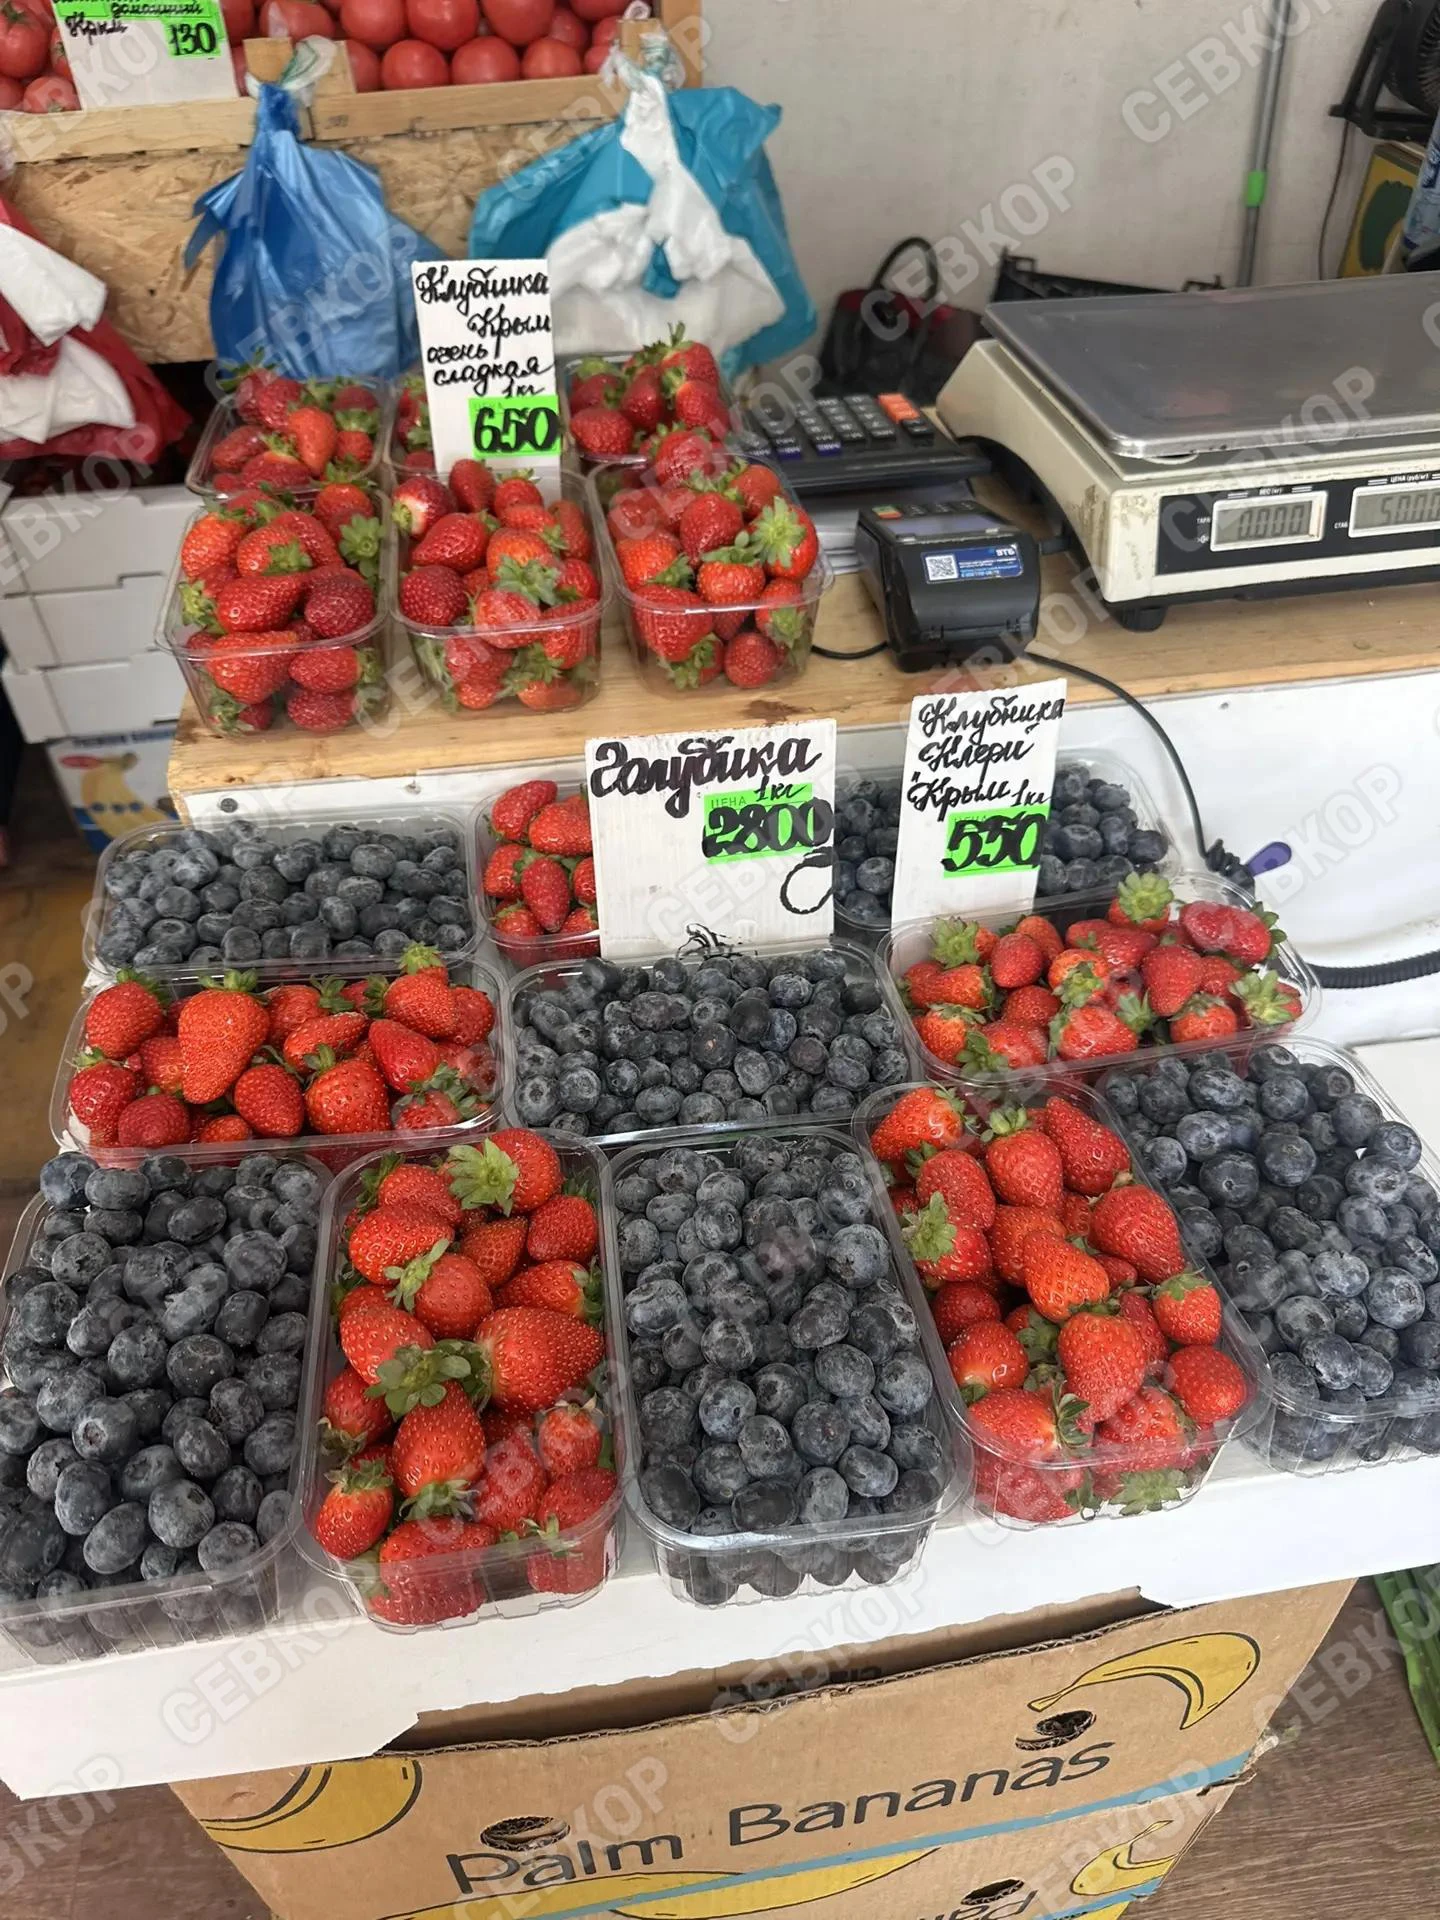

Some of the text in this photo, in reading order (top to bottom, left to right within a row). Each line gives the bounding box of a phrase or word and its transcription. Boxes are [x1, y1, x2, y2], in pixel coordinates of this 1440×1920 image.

[169, 22, 217, 56] 130
[415, 265, 549, 316] Клубника
[427, 343, 489, 364] очень
[467, 303, 552, 359] Крым
[433, 356, 554, 396] сладкая
[474, 406, 561, 453] 650
[919, 695, 1065, 745] Клубника
[590, 736, 823, 819] Голубика
[907, 776, 1011, 823] Крым
[702, 796, 834, 858] 2800
[941, 811, 1049, 872] 550
[446, 1742, 1116, 1894] Palm Bananas
